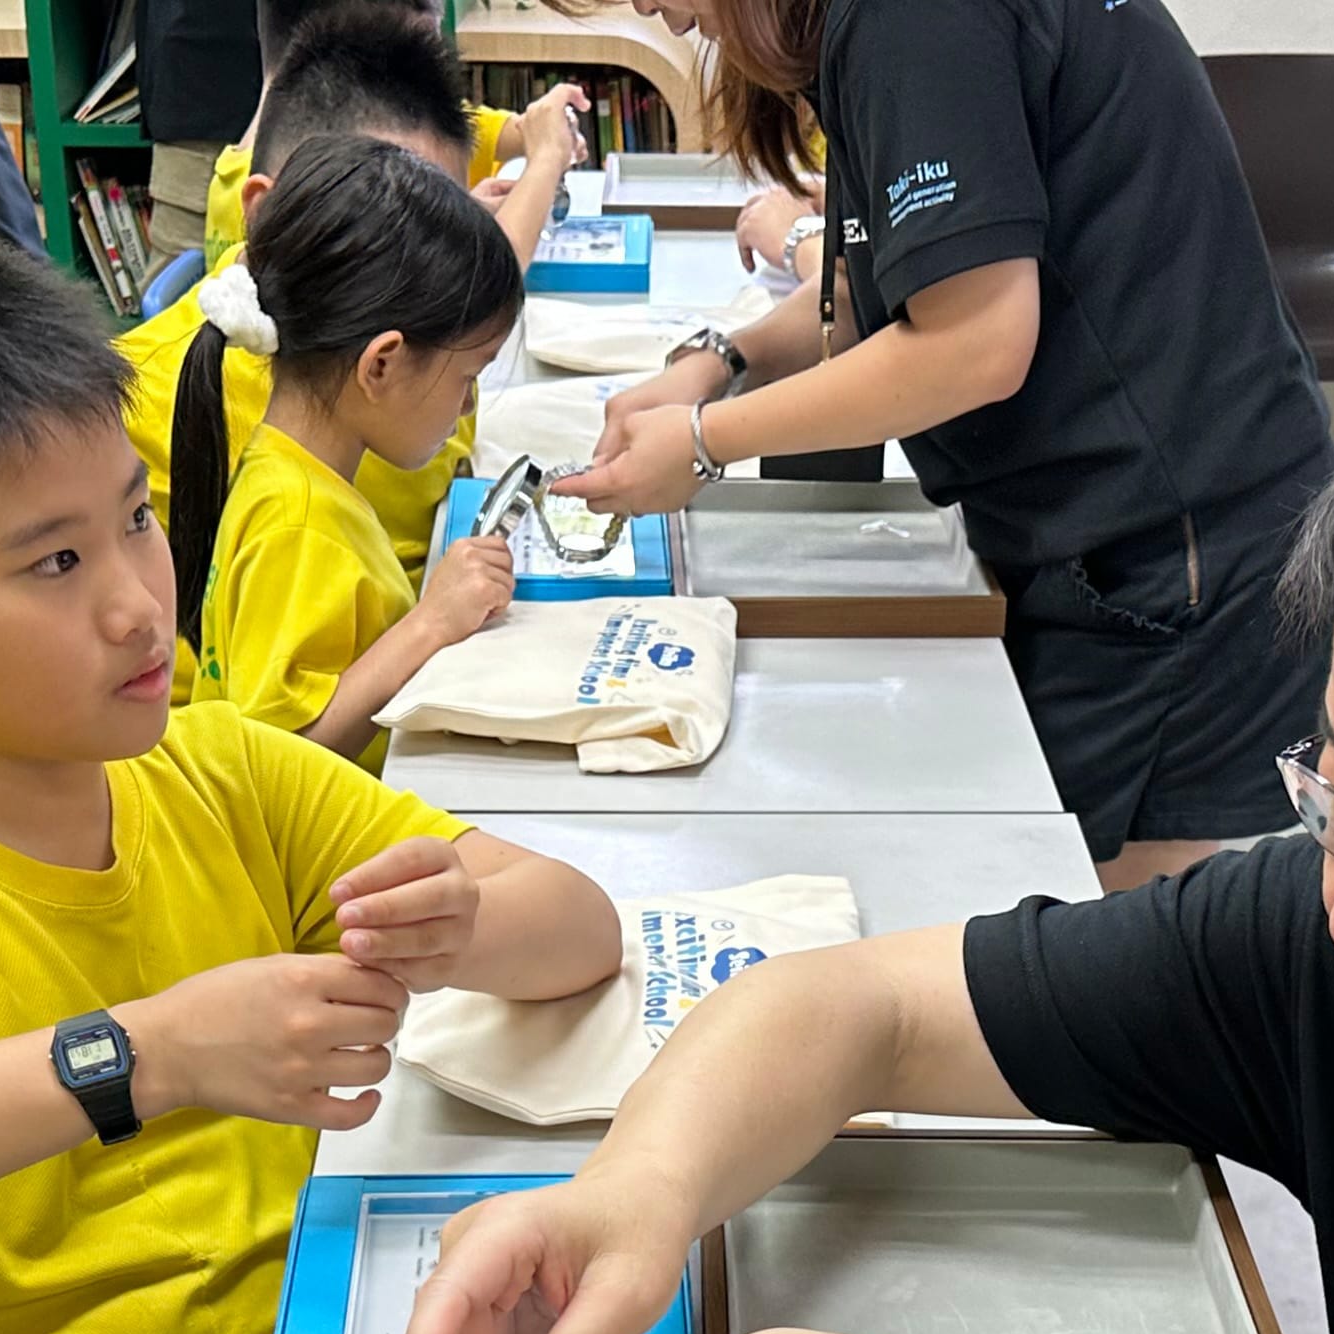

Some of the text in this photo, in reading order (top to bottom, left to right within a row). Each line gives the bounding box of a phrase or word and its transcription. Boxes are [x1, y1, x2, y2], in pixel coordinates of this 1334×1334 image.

[886, 161, 949, 203] Toki-iku
[576, 661, 612, 704] School
[728, 950, 751, 978] Sei
[643, 970, 678, 1028] School
